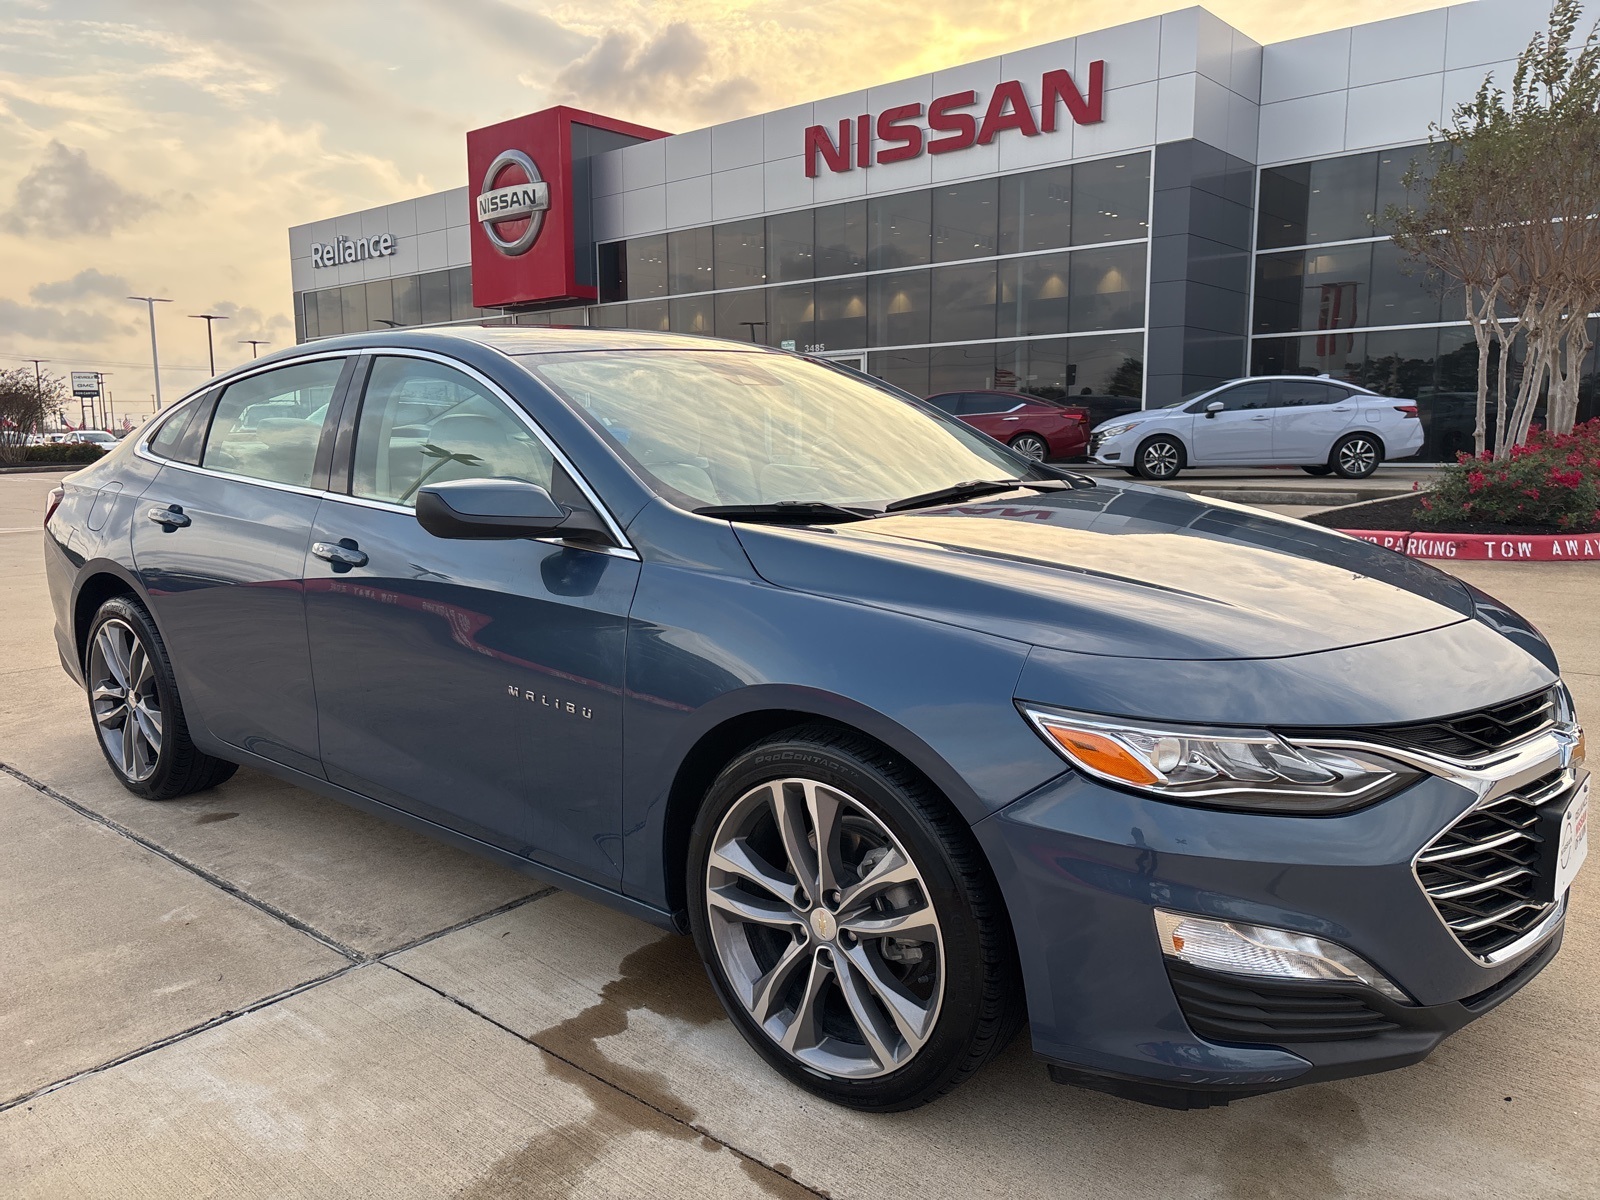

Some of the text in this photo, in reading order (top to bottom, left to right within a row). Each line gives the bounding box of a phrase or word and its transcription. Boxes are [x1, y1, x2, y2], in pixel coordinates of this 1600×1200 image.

[804, 59, 1105, 178] NISSAN
[479, 188, 537, 216] NISSAN
[311, 233, 393, 268] Reliance
[804, 344, 825, 353] 3485
[1384, 537, 1457, 557] PARKING
[1484, 541, 1532, 559] TOW
[508, 685, 592, 719] MALIBU
